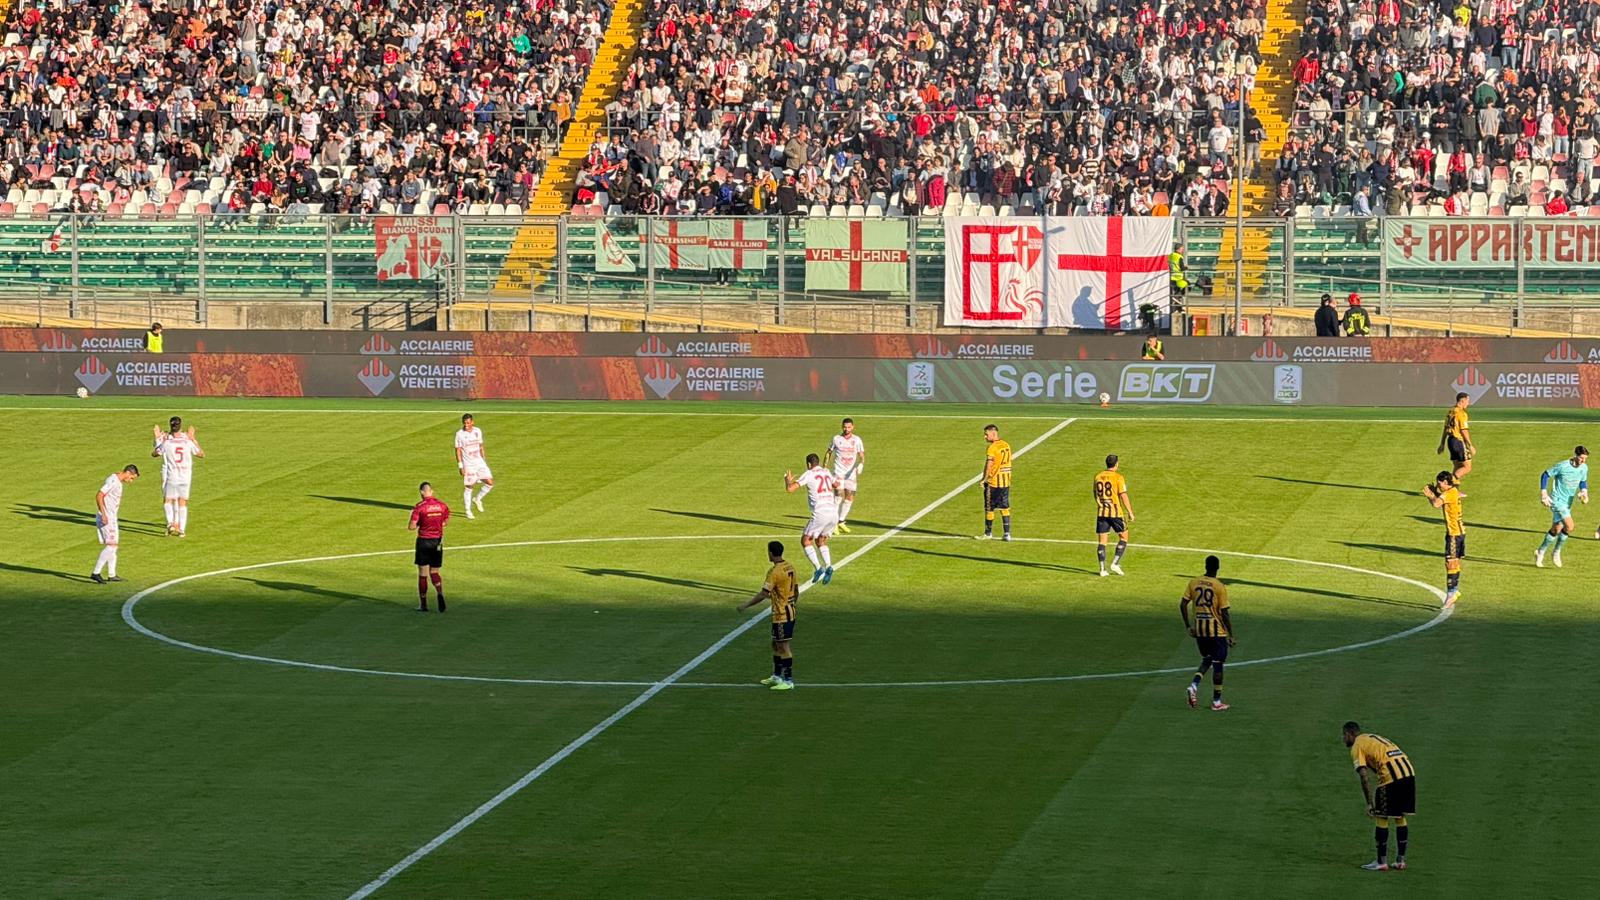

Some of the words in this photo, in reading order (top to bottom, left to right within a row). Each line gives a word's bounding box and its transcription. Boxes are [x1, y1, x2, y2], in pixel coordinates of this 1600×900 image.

[395, 217, 438, 226] AMISSI
[1429, 224, 1600, 262] APPARTEN
[811, 249, 901, 261] VALSUGANA
[81, 337, 144, 348] ACCIAIER
[400, 340, 473, 351] ACCIAIERIE
[676, 342, 752, 353] ACCIAIERIE
[957, 344, 1034, 355] ACCIAIERIE
[1293, 346, 1372, 357] ACCIAIERIE
[116, 363, 192, 374] ACCIAIERIE
[399, 365, 476, 376] ACCIAIERIE
[686, 367, 764, 378] ACCIAIERIE
[992, 364, 1096, 398] Serie
[1124, 372, 1209, 393] BKT
[1496, 373, 1580, 384] ACCIAIERIE
[175, 446, 184, 463] 5
[815, 474, 833, 494] 20
[1096, 481, 1112, 498] 98
